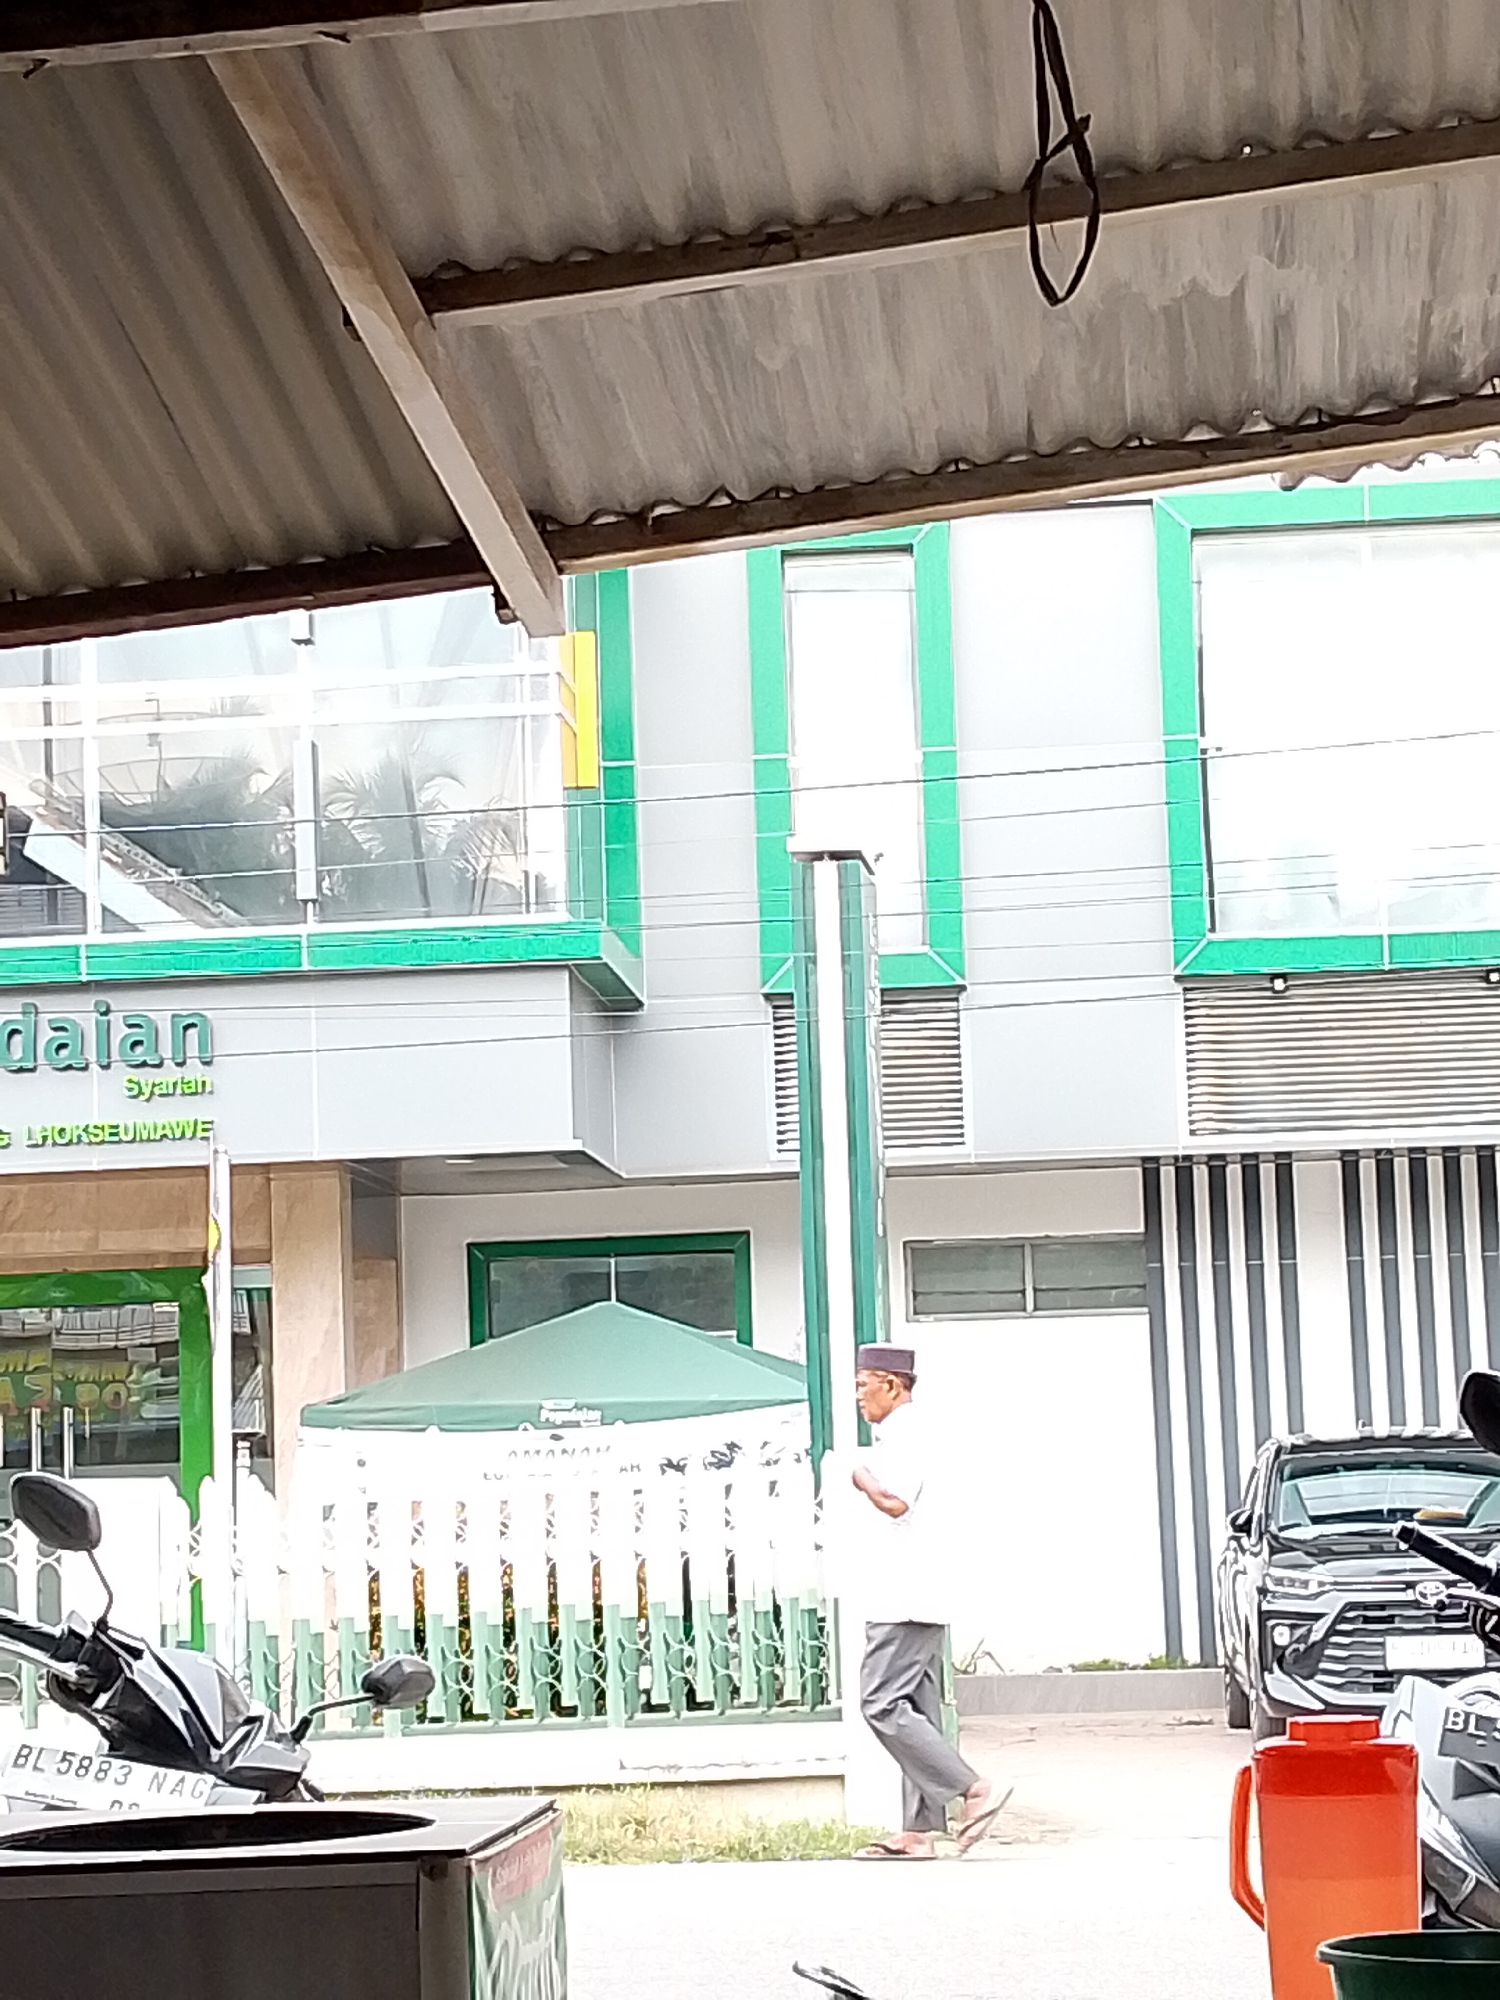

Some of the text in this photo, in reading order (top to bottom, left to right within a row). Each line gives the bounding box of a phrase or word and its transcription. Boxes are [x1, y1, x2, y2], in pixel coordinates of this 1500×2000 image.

[0, 1000, 213, 1072] daian
[123, 1073, 213, 1101] Syariah
[23, 1117, 213, 1148] LHOKSEUMAWE
[1445, 1708, 1487, 1737] BL
[12, 1744, 208, 1800] BL 5883 NAG
